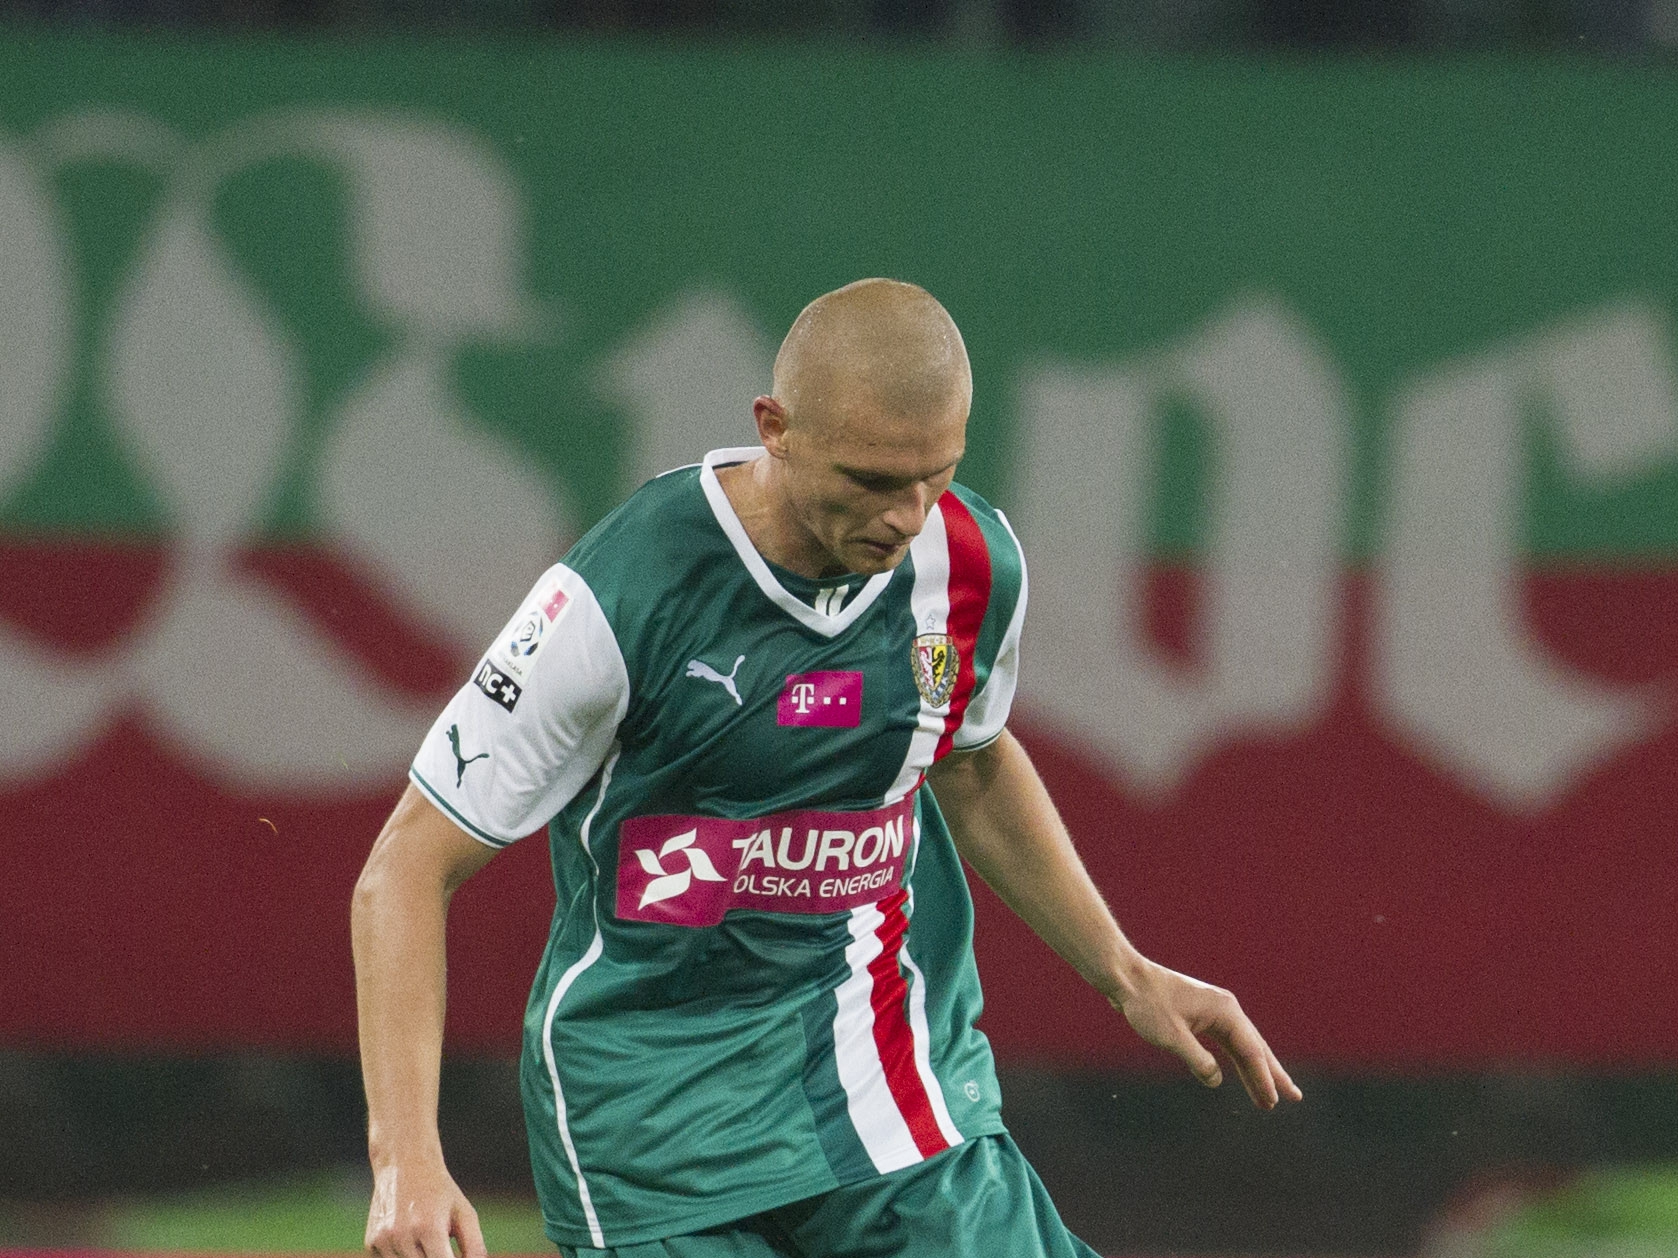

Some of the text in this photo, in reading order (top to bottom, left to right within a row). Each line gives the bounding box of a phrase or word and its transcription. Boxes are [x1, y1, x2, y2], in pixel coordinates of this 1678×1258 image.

[477, 662, 518, 705] nc+
[732, 814, 904, 871] TAURON
[733, 865, 895, 898] OLSKA ENERGIA
